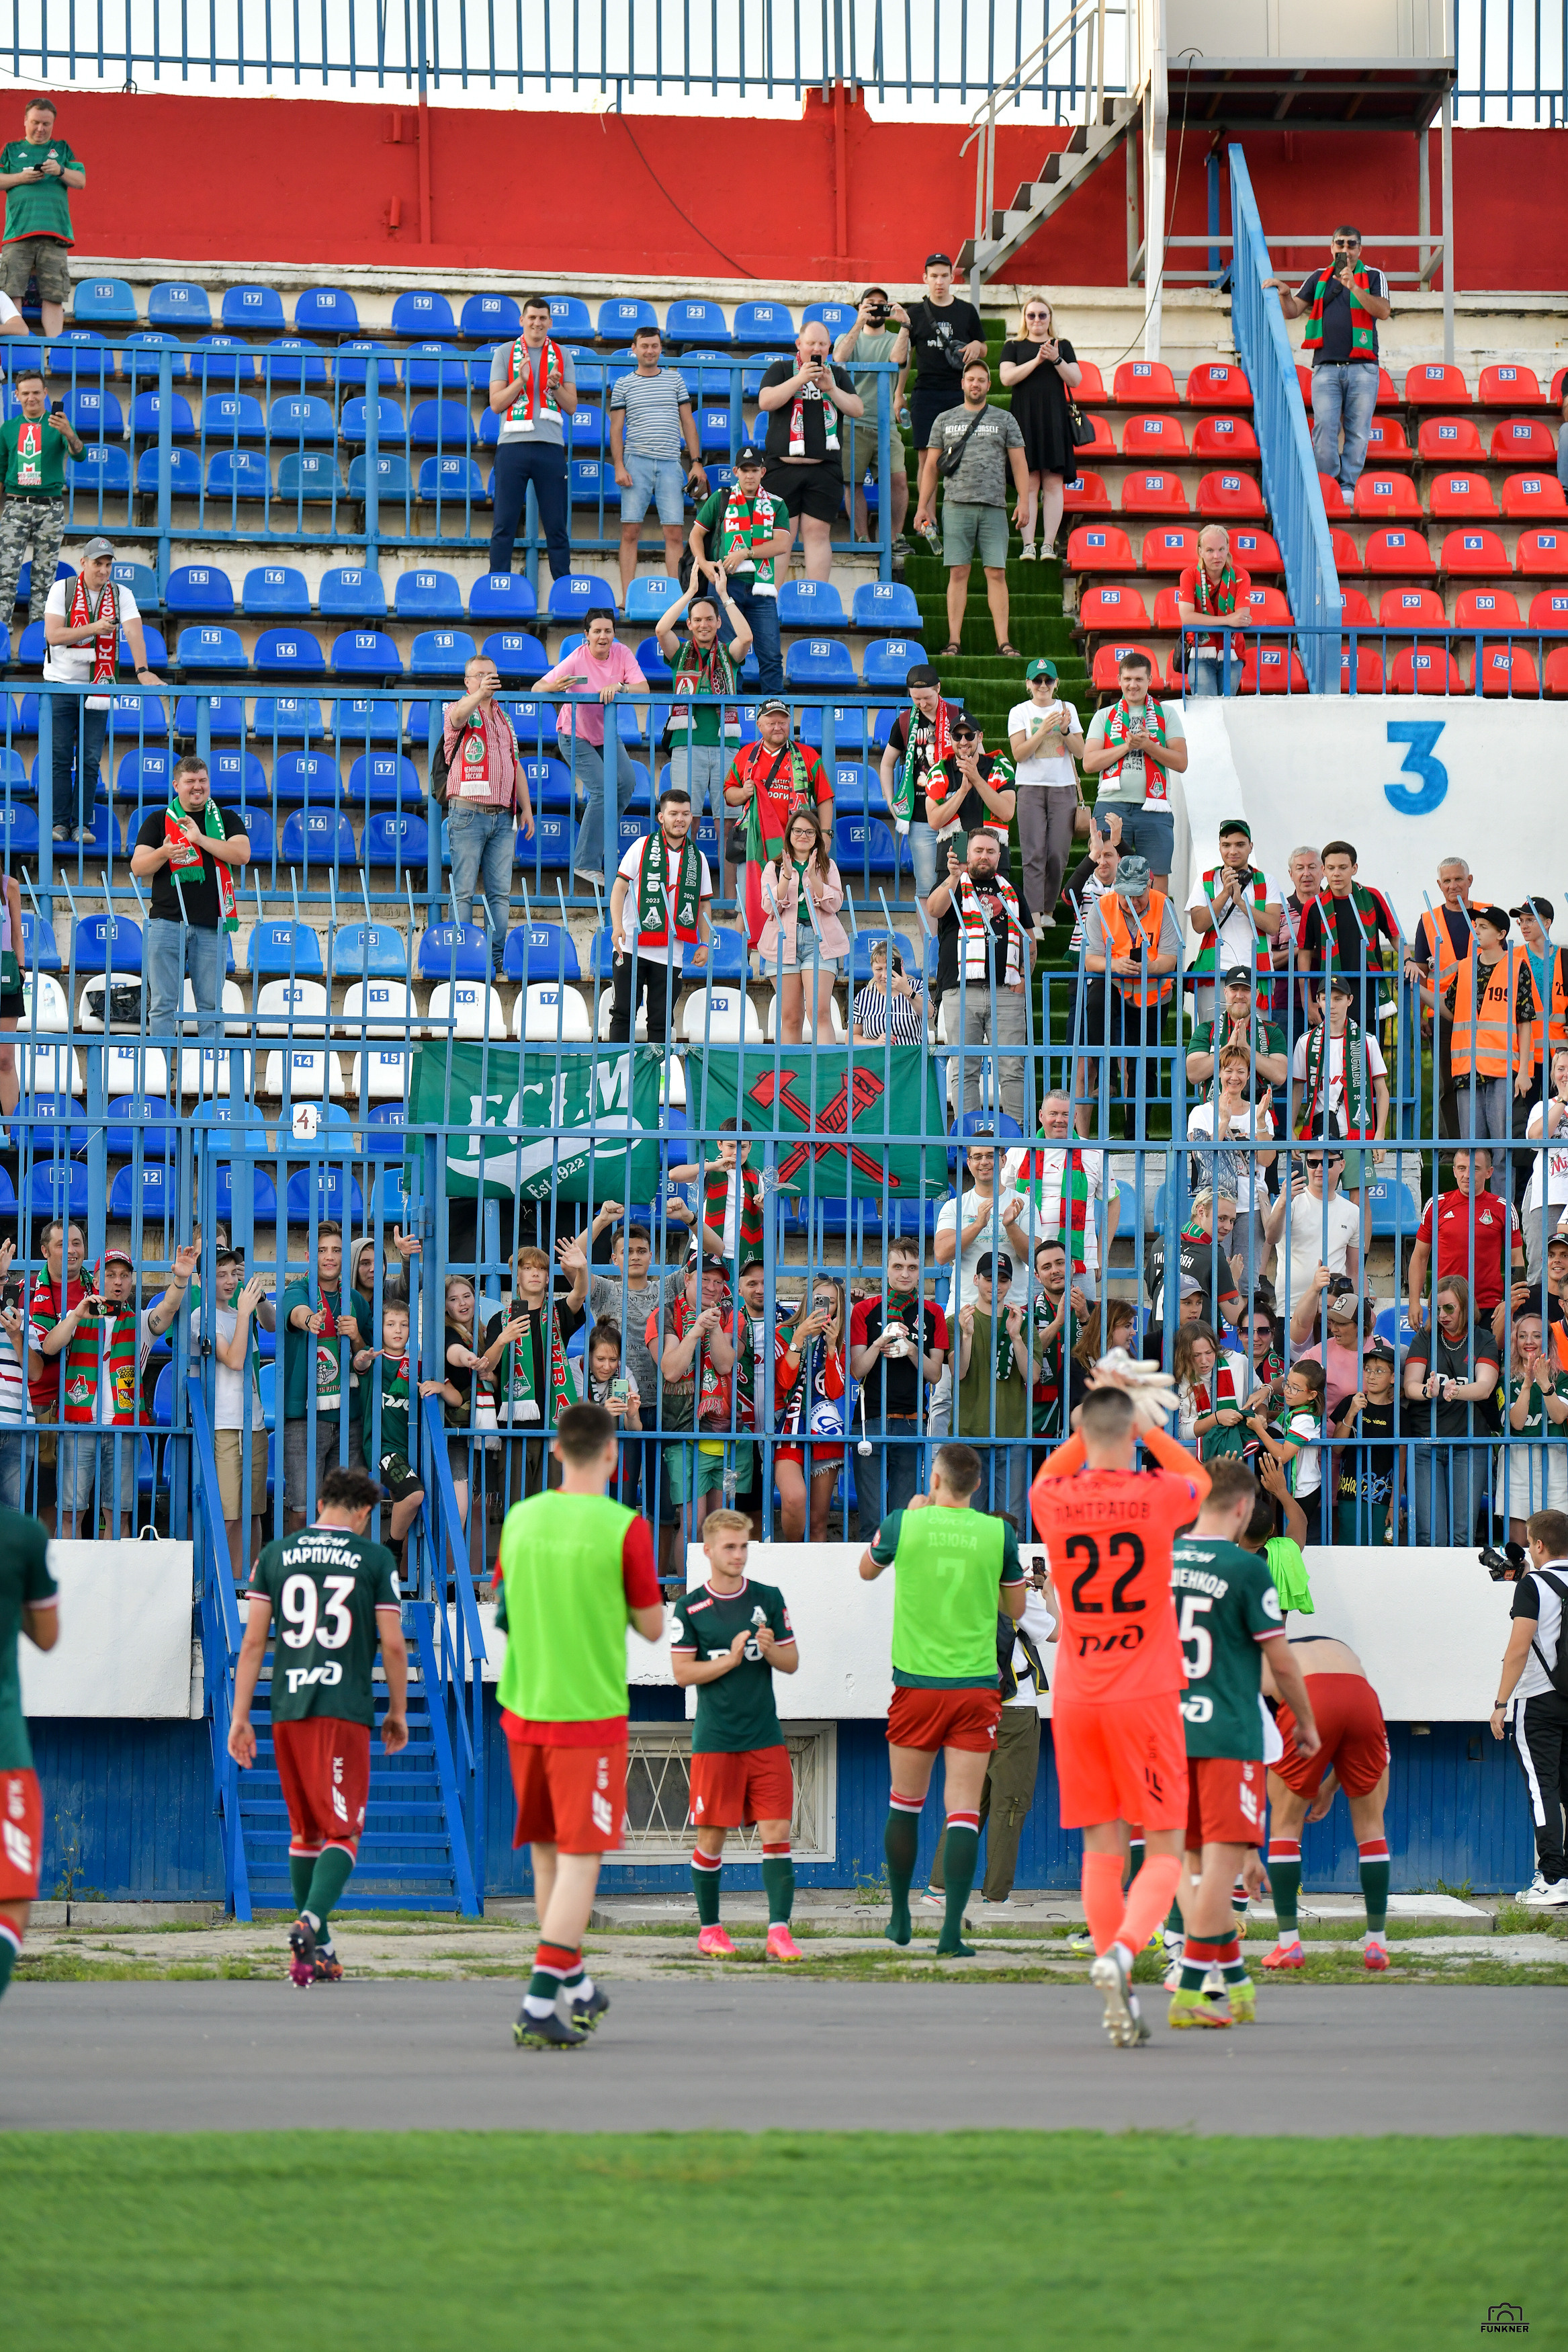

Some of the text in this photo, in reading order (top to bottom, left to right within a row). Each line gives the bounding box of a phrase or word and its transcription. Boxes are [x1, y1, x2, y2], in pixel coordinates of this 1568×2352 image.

[98, 288, 111, 296] 15
[173, 291, 185, 299] 16
[247, 295, 259, 303] 17
[320, 296, 333, 304] 18
[417, 299, 429, 307] 19
[485, 301, 498, 309] 20
[553, 305, 564, 313] 21
[622, 307, 634, 315] 22
[690, 308, 702, 317] 23
[757, 310, 770, 318] 24
[826, 311, 841, 320] 25
[1136, 366, 1149, 374] 28
[1213, 370, 1225, 378] 29
[1429, 369, 1441, 378] 32
[1501, 370, 1514, 378] 33
[84, 397, 97, 406] 15
[224, 404, 235, 412] 17
[576, 415, 589, 423] 22
[711, 417, 724, 425] 24
[974, 425, 1000, 434] OURSELF
[1147, 423, 1160, 431] 28
[1218, 423, 1231, 431] 29
[1442, 429, 1454, 437] 32
[1516, 428, 1528, 436] 33
[303, 460, 316, 469] 18
[443, 462, 456, 470] 20
[582, 466, 595, 474] 22
[1148, 479, 1160, 487] 28
[1225, 479, 1237, 488] 29
[1454, 482, 1467, 491] 32
[1526, 482, 1538, 491] 33
[1377, 485, 1389, 493] 31
[1094, 536, 1098, 544] 1
[1171, 537, 1178, 546] 2
[1244, 539, 1250, 547] 3
[1393, 536, 1399, 544] 5
[1470, 539, 1477, 548] 6
[1544, 538, 1550, 546] 7
[118, 569, 131, 577] 14
[192, 573, 206, 581] 15
[269, 572, 282, 581] 16
[345, 574, 358, 583] 17
[420, 577, 433, 585] 18
[494, 579, 507, 587] 19
[574, 582, 587, 591] 20
[650, 582, 662, 591] 21
[800, 584, 813, 593] 23
[877, 587, 890, 596] 24
[1104, 593, 1117, 601] 25
[1251, 594, 1262, 602] 27
[1405, 597, 1418, 605] 29
[1479, 599, 1492, 607] 30
[1555, 599, 1567, 608] 31
[205, 632, 218, 641] 15
[437, 636, 451, 645] 18
[359, 638, 373, 646] 17
[506, 639, 519, 647] 19
[99, 644, 112, 660] FC
[280, 646, 294, 655] 16
[814, 644, 826, 654] 23
[889, 644, 903, 653] 24
[1264, 654, 1278, 662] 27
[124, 698, 138, 708] 14
[280, 699, 294, 708] 16
[519, 704, 532, 713] 19
[147, 761, 161, 770] 14
[223, 760, 236, 769] 15
[378, 763, 392, 772] 17
[464, 765, 484, 773] ЧЕМПИОН
[1384, 721, 1448, 814] 3
[840, 773, 854, 782] 23
[310, 818, 324, 828] 16
[543, 824, 558, 833] 19
[623, 825, 638, 833] 20
[699, 829, 712, 837] 21
[685, 844, 698, 886] МОСКВА
[646, 872, 661, 892] ФК
[276, 933, 290, 942] 14
[531, 934, 545, 943] 17
[372, 991, 386, 1000] 15
[458, 992, 473, 1001] 16
[543, 993, 557, 1003] 17
[711, 1000, 726, 1009] 19
[121, 1048, 134, 1058] 12
[296, 1056, 312, 1066] 14
[383, 1053, 398, 1063] 15
[42, 1107, 54, 1116] 11
[297, 1109, 308, 1129] 4
[143, 1172, 158, 1182] 12
[1368, 1186, 1384, 1196] 26
[928, 1532, 977, 1550] ДЗЮБА
[282, 1547, 361, 1569] КАРПУКАС
[1065, 1532, 1145, 1613] 22
[937, 1558, 966, 1620] 7
[281, 1574, 355, 1649] 93
[1171, 1595, 1213, 1679] 5
